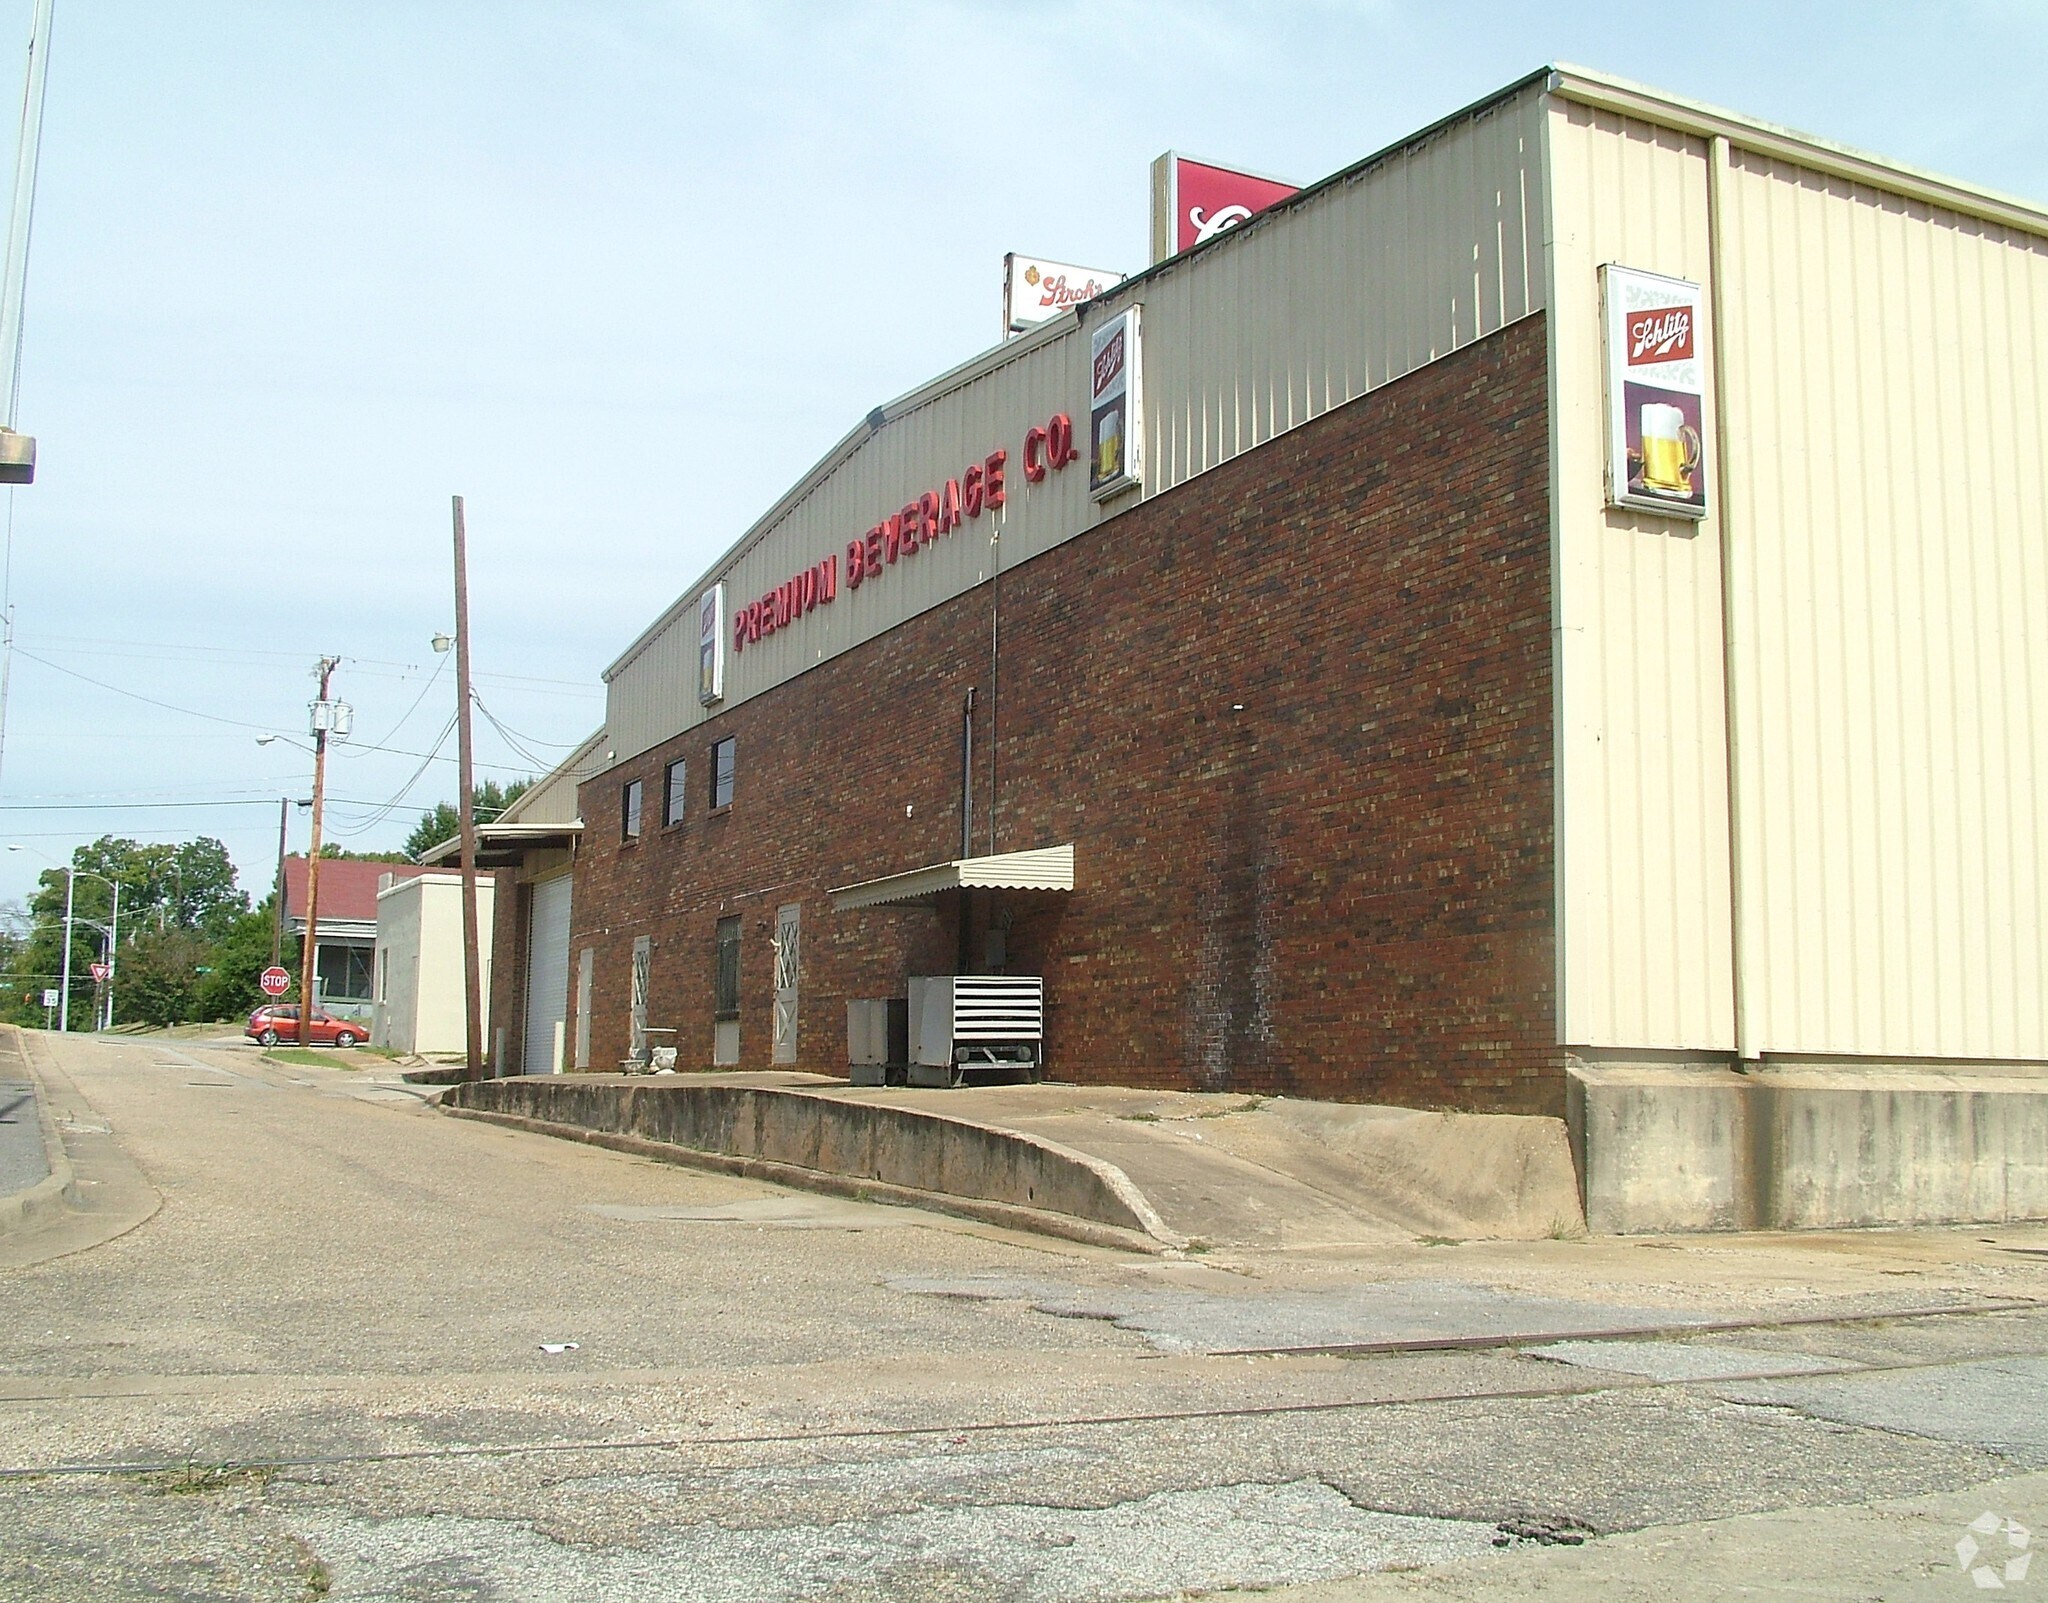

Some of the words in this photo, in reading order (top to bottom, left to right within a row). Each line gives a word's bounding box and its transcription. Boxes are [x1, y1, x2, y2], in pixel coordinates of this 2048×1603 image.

[1632, 311, 1689, 358] Schlitz
[734, 554, 837, 652] PREMIUM
[846, 449, 1007, 590] BEVERAGE
[1023, 412, 1079, 483] CO.
[263, 975, 288, 987] STOP
